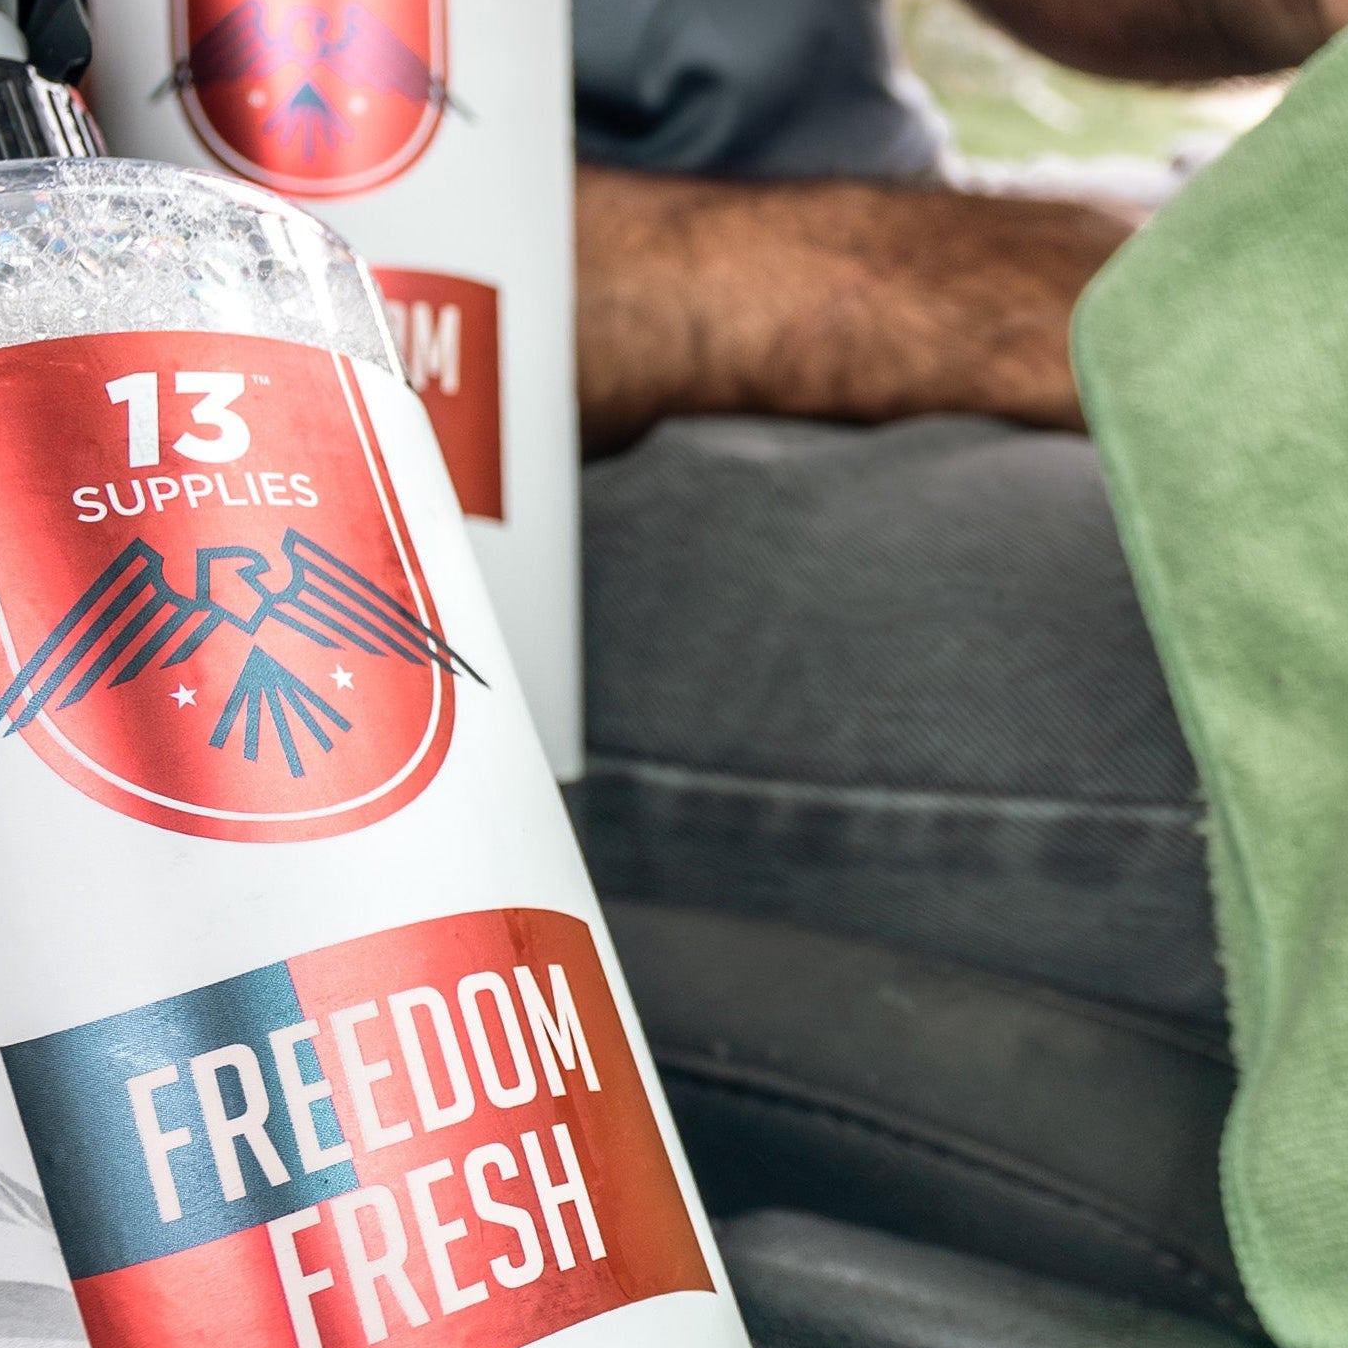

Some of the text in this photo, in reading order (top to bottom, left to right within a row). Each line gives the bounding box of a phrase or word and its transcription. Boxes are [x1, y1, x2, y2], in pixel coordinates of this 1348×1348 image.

[105, 371, 251, 468] 13
[72, 472, 319, 523] SUPPLIES
[125, 964, 602, 1223] FREEDOM
